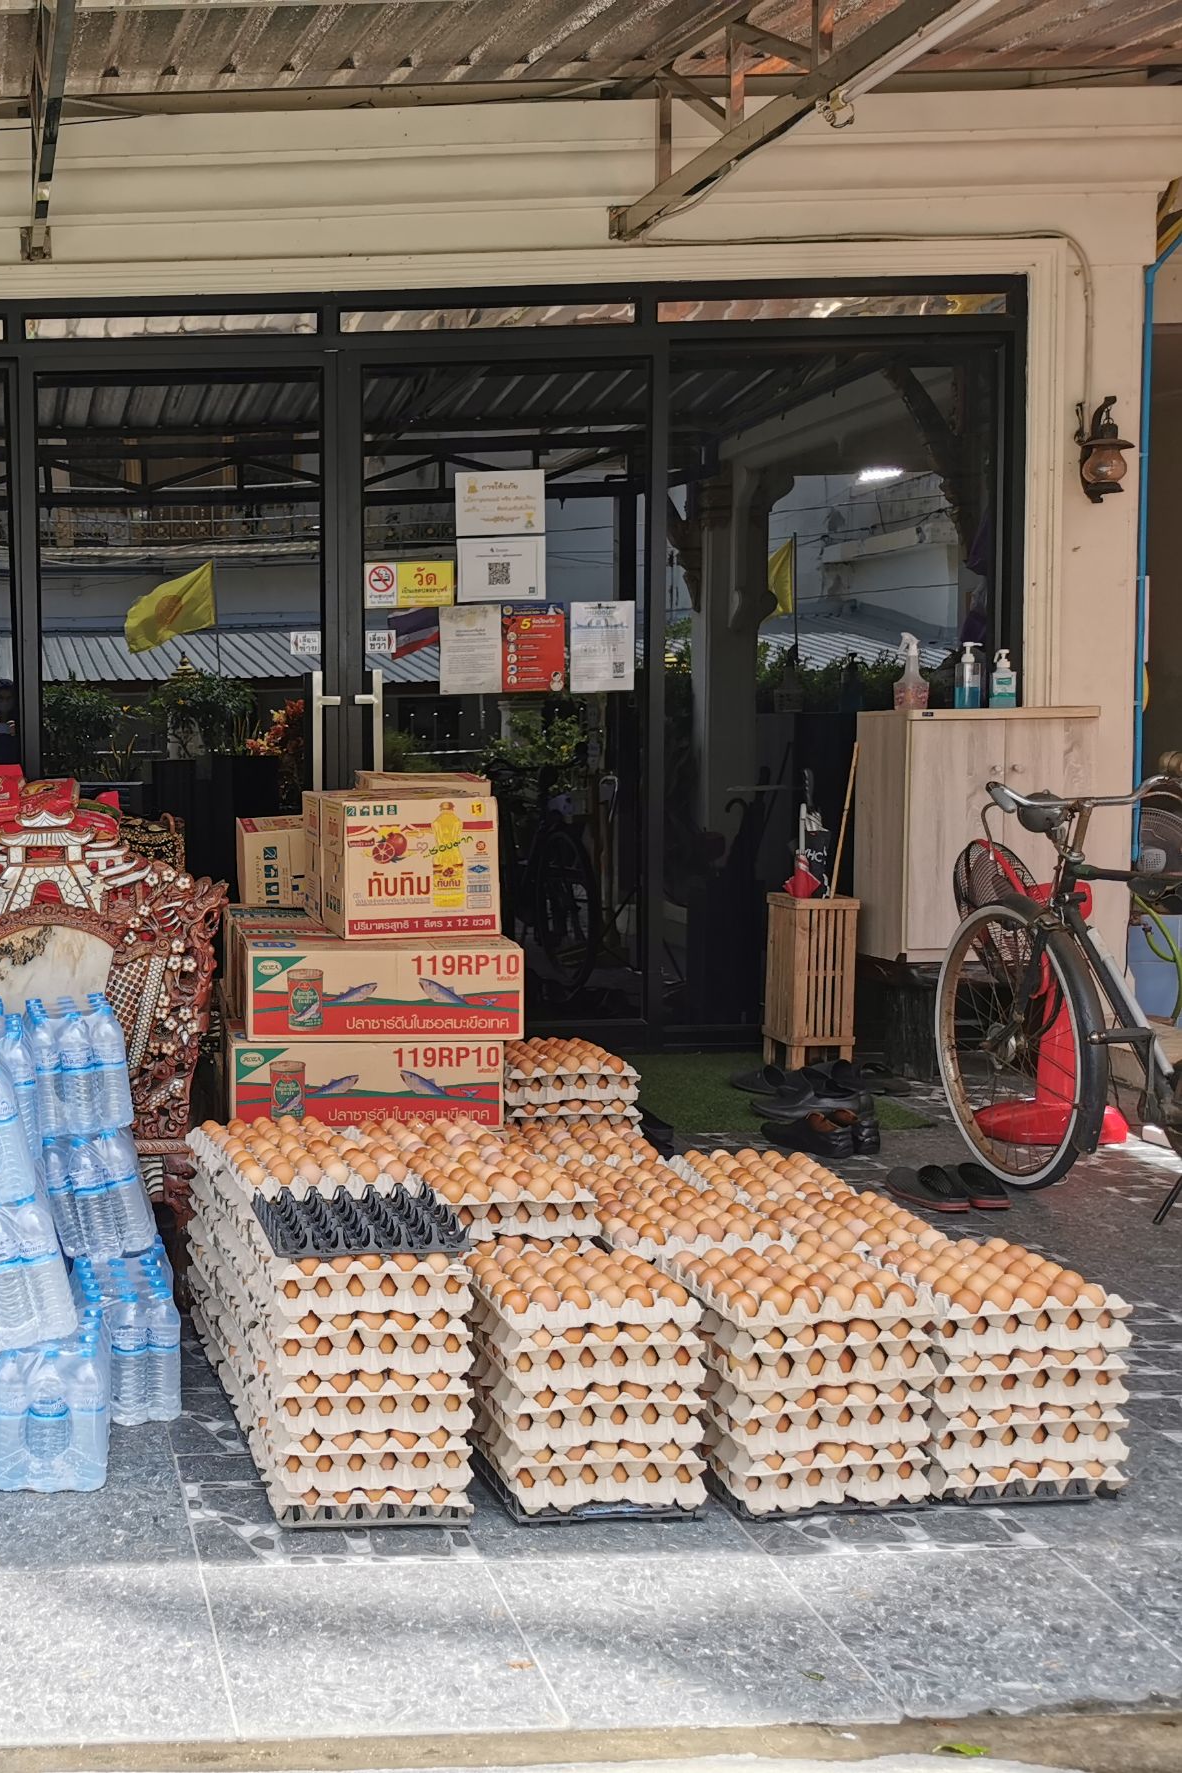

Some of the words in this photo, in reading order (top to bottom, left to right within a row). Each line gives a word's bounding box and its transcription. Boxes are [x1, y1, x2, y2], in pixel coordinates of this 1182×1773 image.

[413, 566, 437, 586] วัด
[520, 618, 531, 630] 5
[369, 633, 387, 642] เลื่อน
[369, 642, 387, 650] ขวา
[367, 871, 431, 898] ทับทิม
[353, 919, 410, 932] ปริมาตรสุทธิ
[413, 920, 419, 929] 1
[424, 919, 443, 928] ลิตร
[456, 918, 469, 927] 12
[472, 918, 492, 927] ขวด
[411, 954, 520, 976] 119RP10
[345, 1015, 510, 1031] ปลาซาร์ดีนในซอสมะเขือเทศ
[393, 1046, 500, 1068] 119RP10
